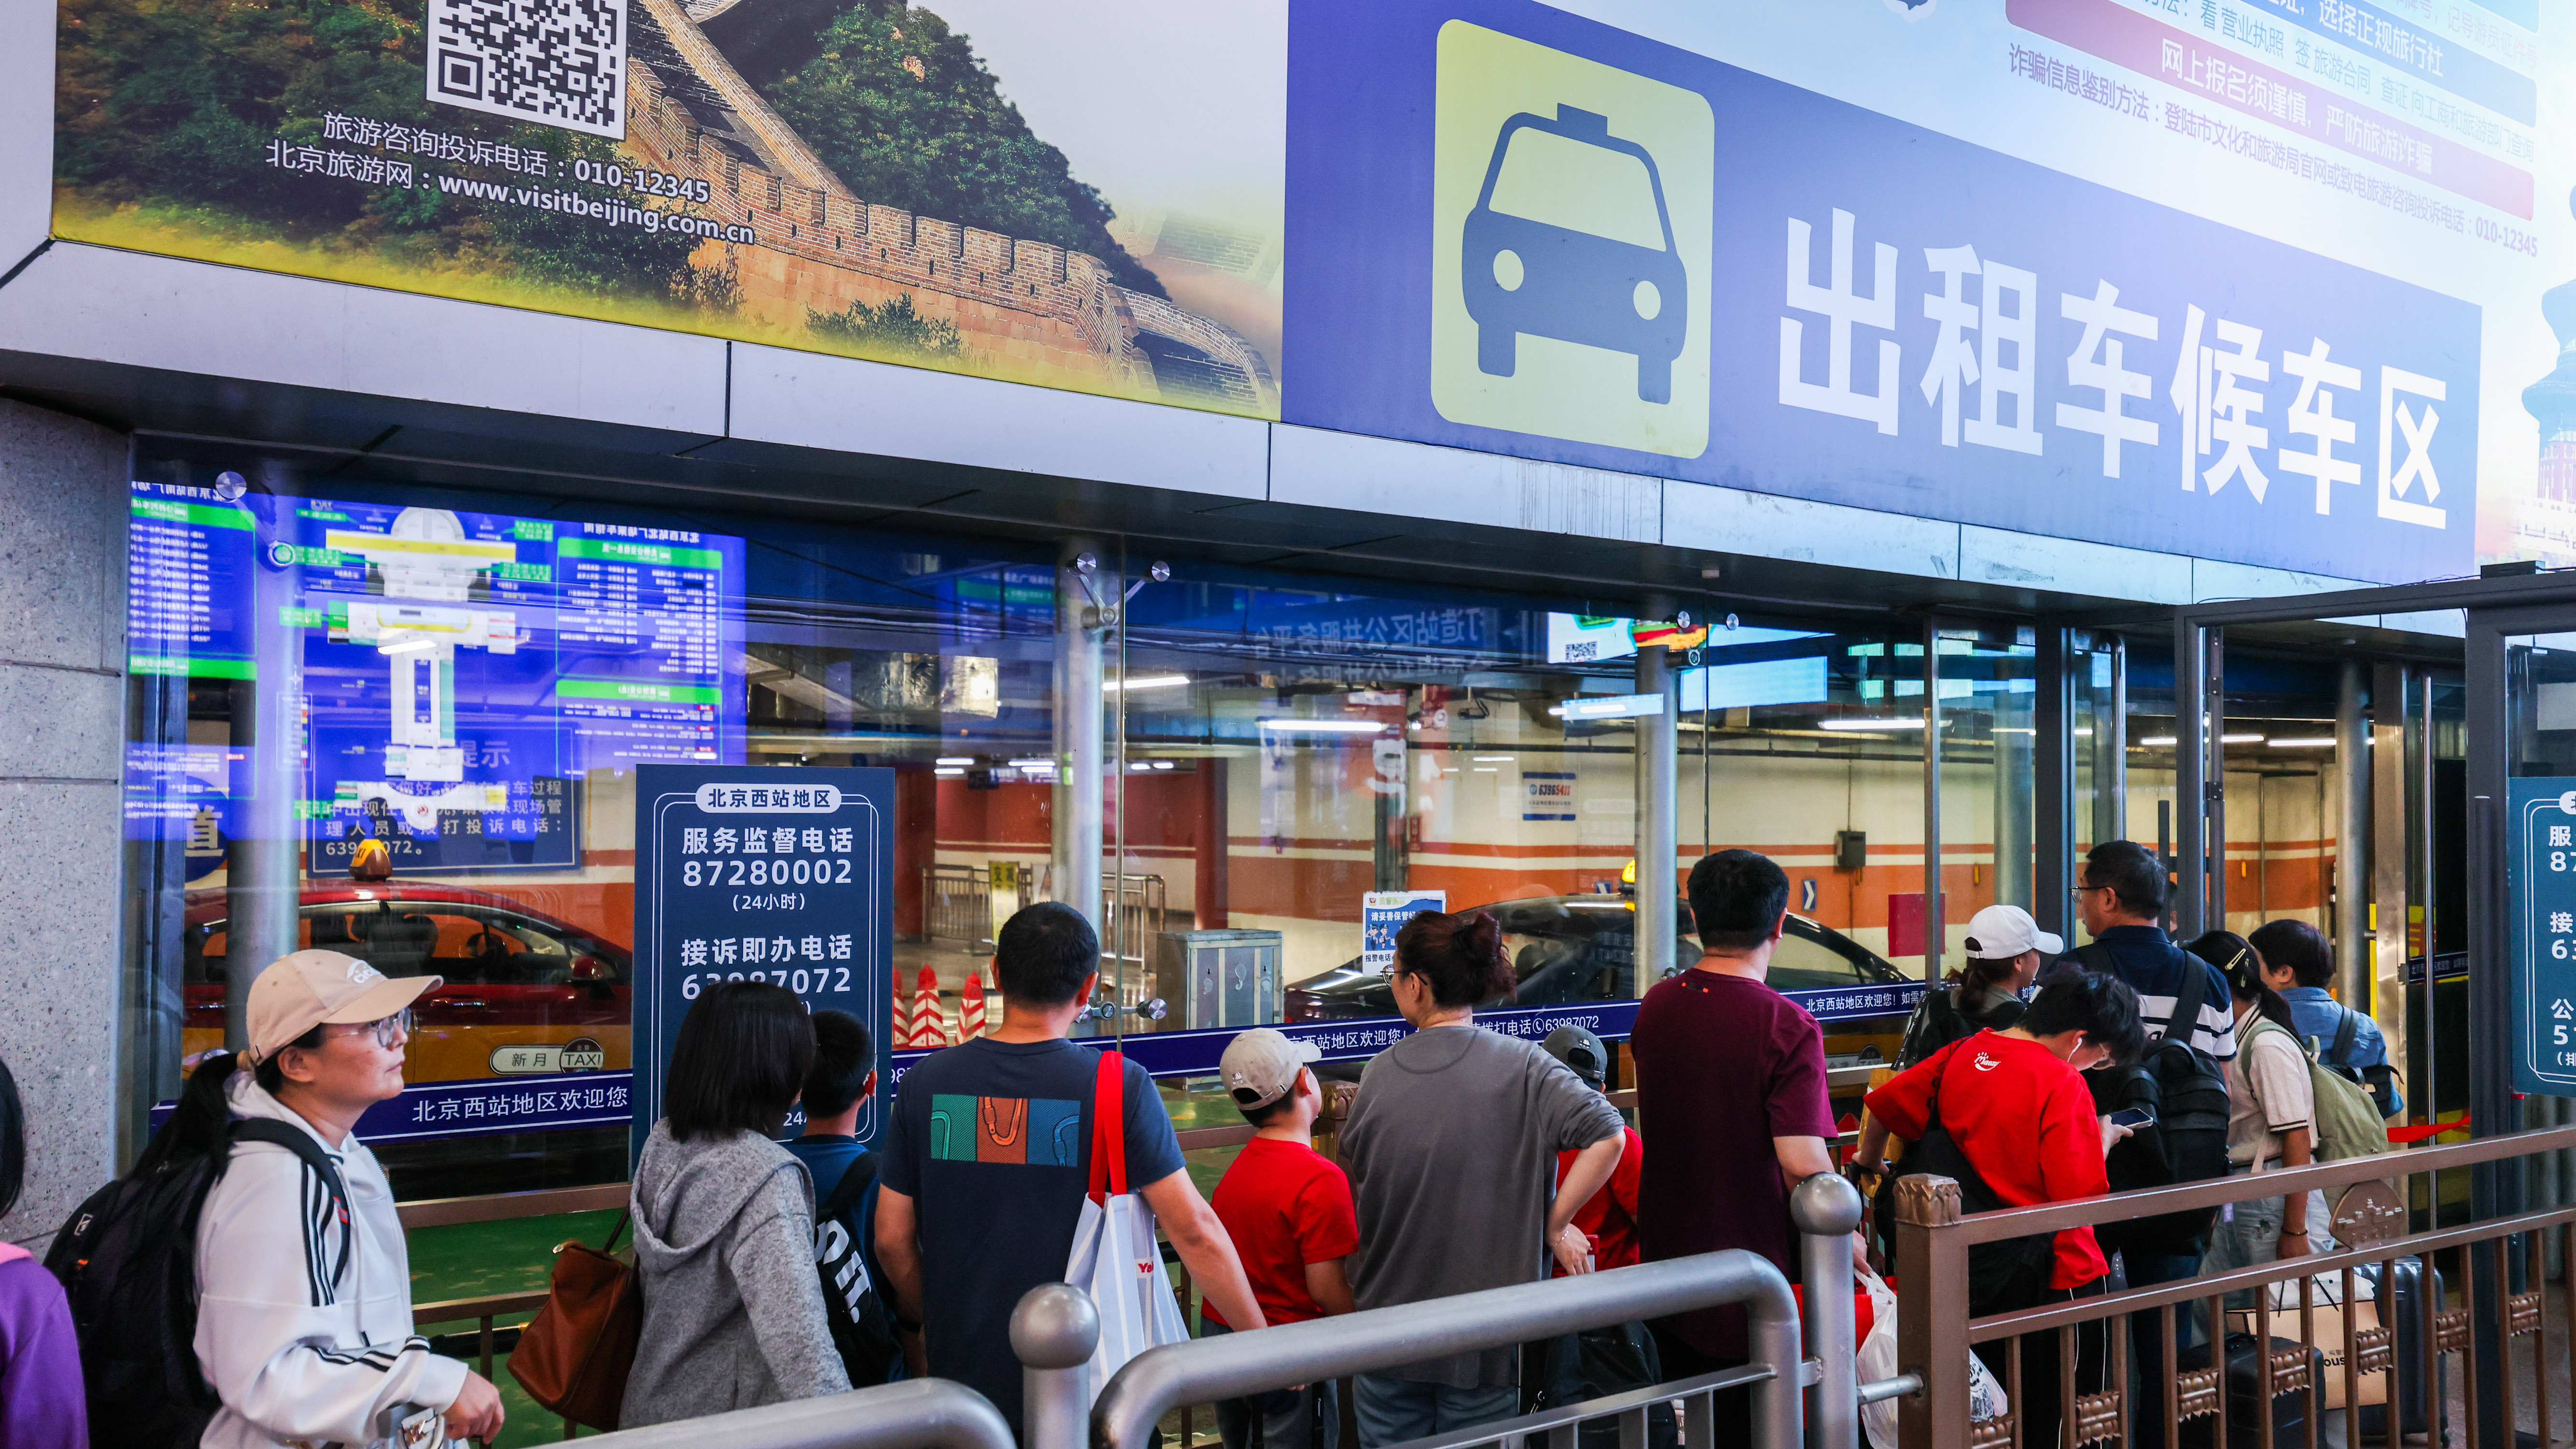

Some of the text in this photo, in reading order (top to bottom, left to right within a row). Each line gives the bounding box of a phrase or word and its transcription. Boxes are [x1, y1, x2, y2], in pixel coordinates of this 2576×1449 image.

[2162, 38, 2433, 175] 网上报名须谨慎，严防旅游诈骗
[322, 111, 710, 203] 旅游咨询投诉电话：010-12345
[1779, 208, 2446, 530] 出租车候车区
[707, 789, 831, 808] 北京西站地区
[682, 827, 854, 855] 服务监督电话
[683, 859, 852, 887] 87280002
[732, 893, 806, 912] (24小时)
[681, 934, 853, 966] 接诉即办电话
[512, 1052, 546, 1067] 新月
[564, 1053, 601, 1066] TAXI
[412, 1086, 628, 1123] 北京西站地区欢迎您
